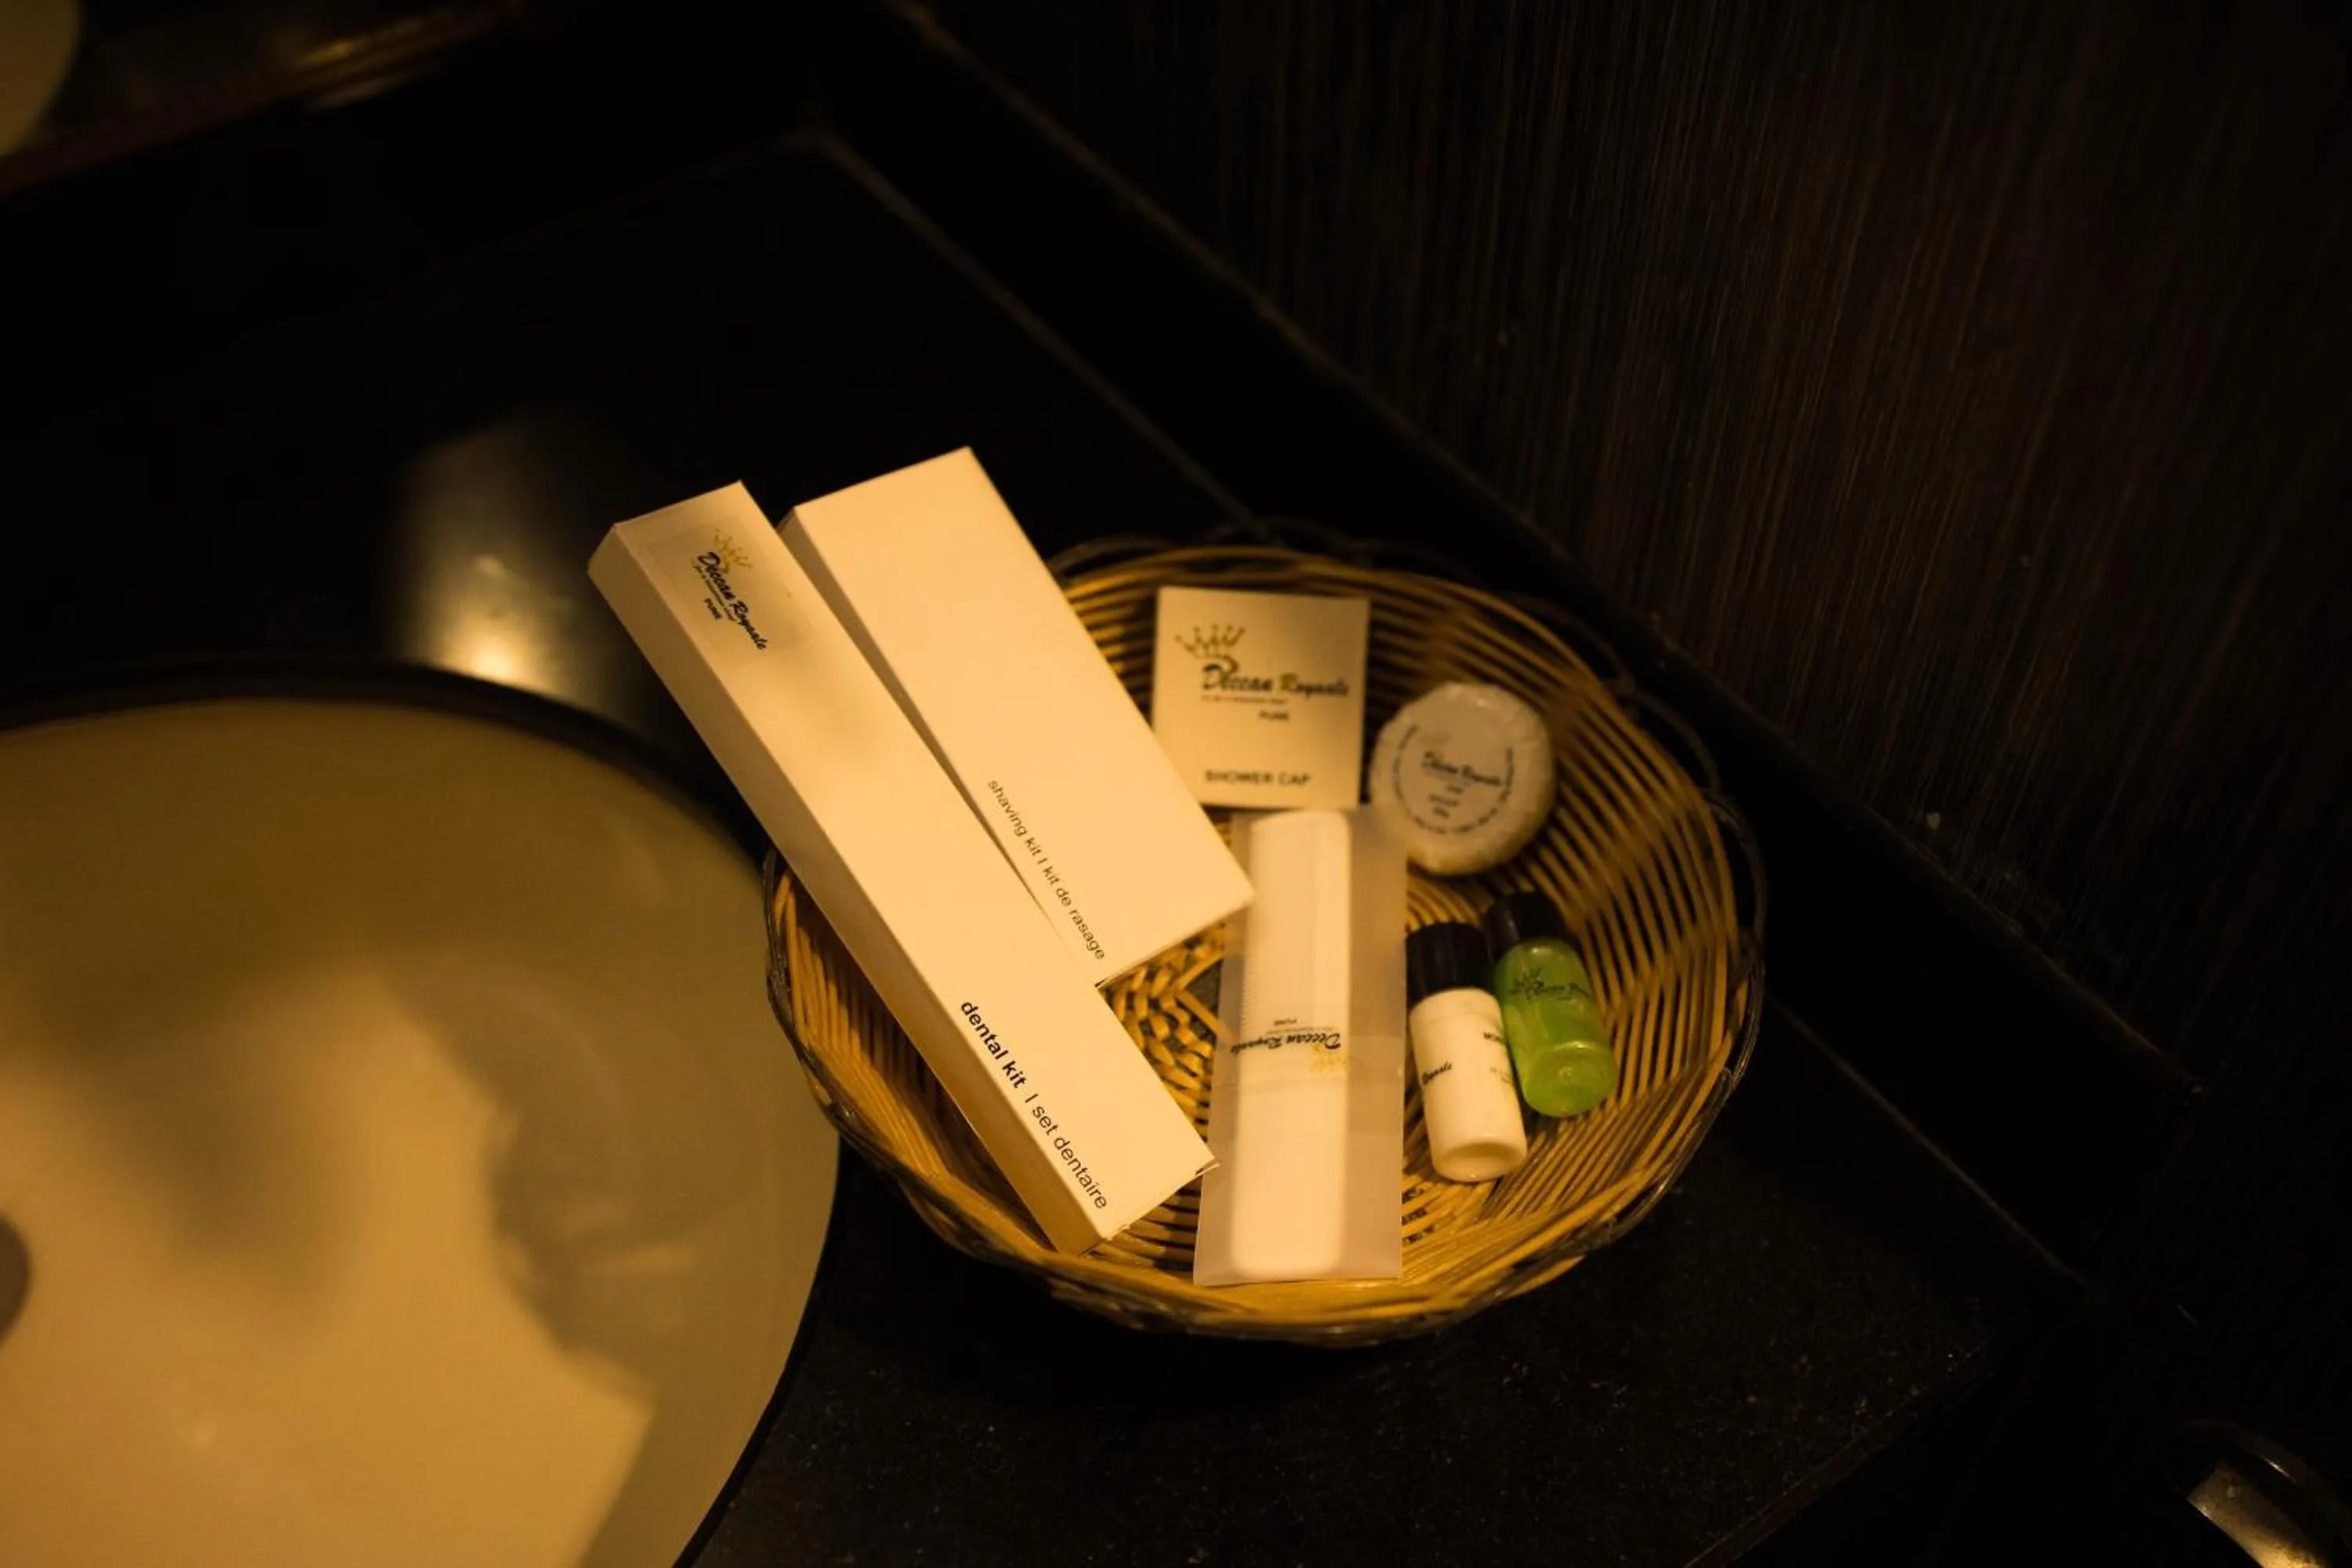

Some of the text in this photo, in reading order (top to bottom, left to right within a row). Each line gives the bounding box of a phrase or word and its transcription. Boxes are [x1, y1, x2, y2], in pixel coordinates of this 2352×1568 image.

[697, 551, 735, 601] Deccan
[1205, 769, 1312, 786] SHOWER CAP
[988, 780, 1028, 837] shaving
[1025, 837, 1042, 857] kit
[1043, 866, 1060, 886] kit
[1055, 887, 1072, 906] de
[1069, 909, 1105, 960] rasage
[1287, 1033, 1341, 1050] Deccan
[960, 1001, 1009, 1060] dental
[1002, 1061, 1027, 1089] kit
[1033, 1105, 1059, 1136] set
[1053, 1137, 1108, 1209] dentaire
